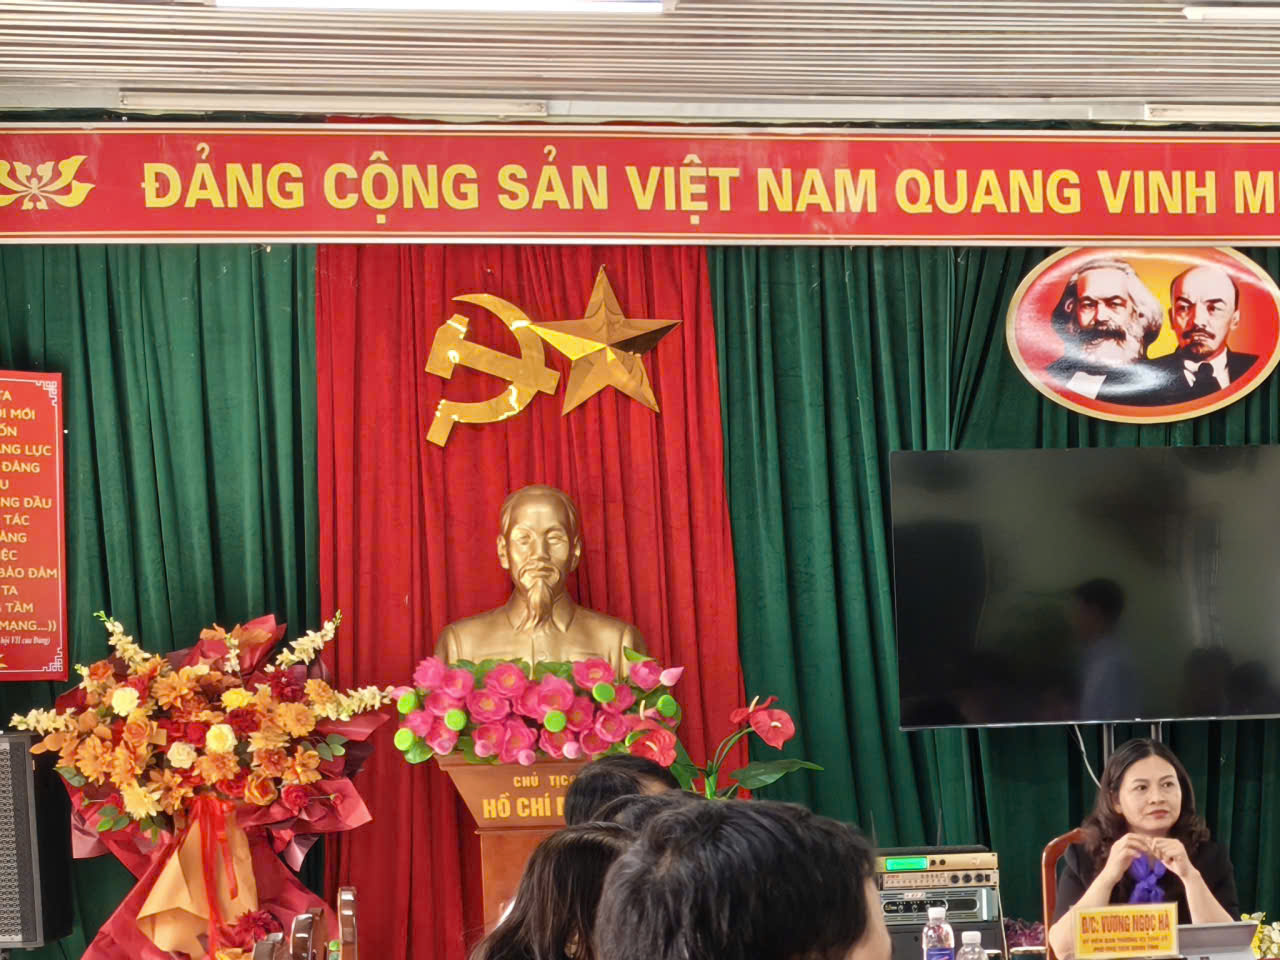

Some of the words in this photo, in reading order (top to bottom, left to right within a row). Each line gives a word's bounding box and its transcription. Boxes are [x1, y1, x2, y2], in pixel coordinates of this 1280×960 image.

[142, 142, 305, 210] ĐẢNG
[323, 150, 479, 224] CỘNG
[498, 146, 608, 211] SẢN
[635, 154, 739, 224] VIỆT
[758, 167, 877, 213] NAM
[895, 168, 1081, 216] QUANG
[1097, 171, 1217, 214] VINH
[4, 512, 30, 526] TÁC
[1, 585, 18, 596] TA
[513, 771, 539, 787] CHỦ
[483, 791, 511, 818] HỒ
[517, 793, 551, 817] CHÍ
